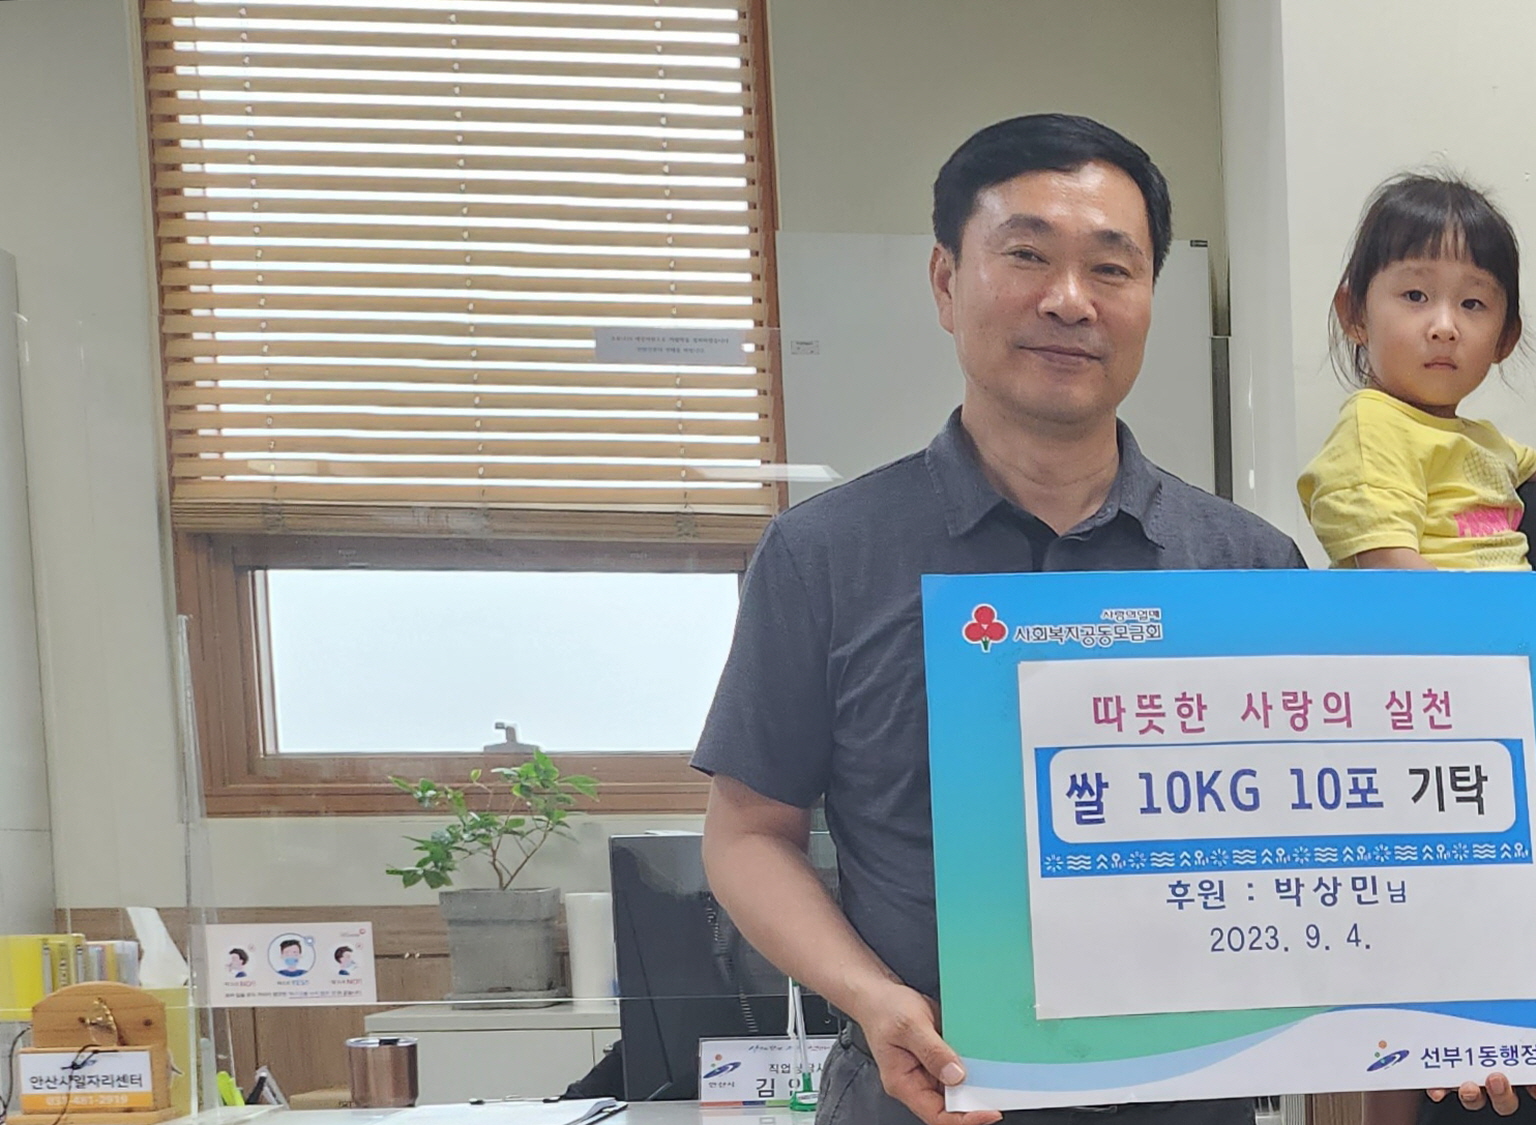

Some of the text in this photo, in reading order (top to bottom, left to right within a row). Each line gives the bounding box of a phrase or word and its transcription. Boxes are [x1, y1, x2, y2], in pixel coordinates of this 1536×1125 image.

[1102, 609, 1161, 622] 사랑의열매
[1013, 623, 1162, 647] 사회복지공동모금회
[1093, 687, 1454, 735] 따뜻한 사랑의 실천
[1065, 764, 1489, 826] 쌀 10KG 10포 기탁
[1166, 879, 1227, 910] 후원
[1210, 922, 1371, 952] 2023. 9. 4.
